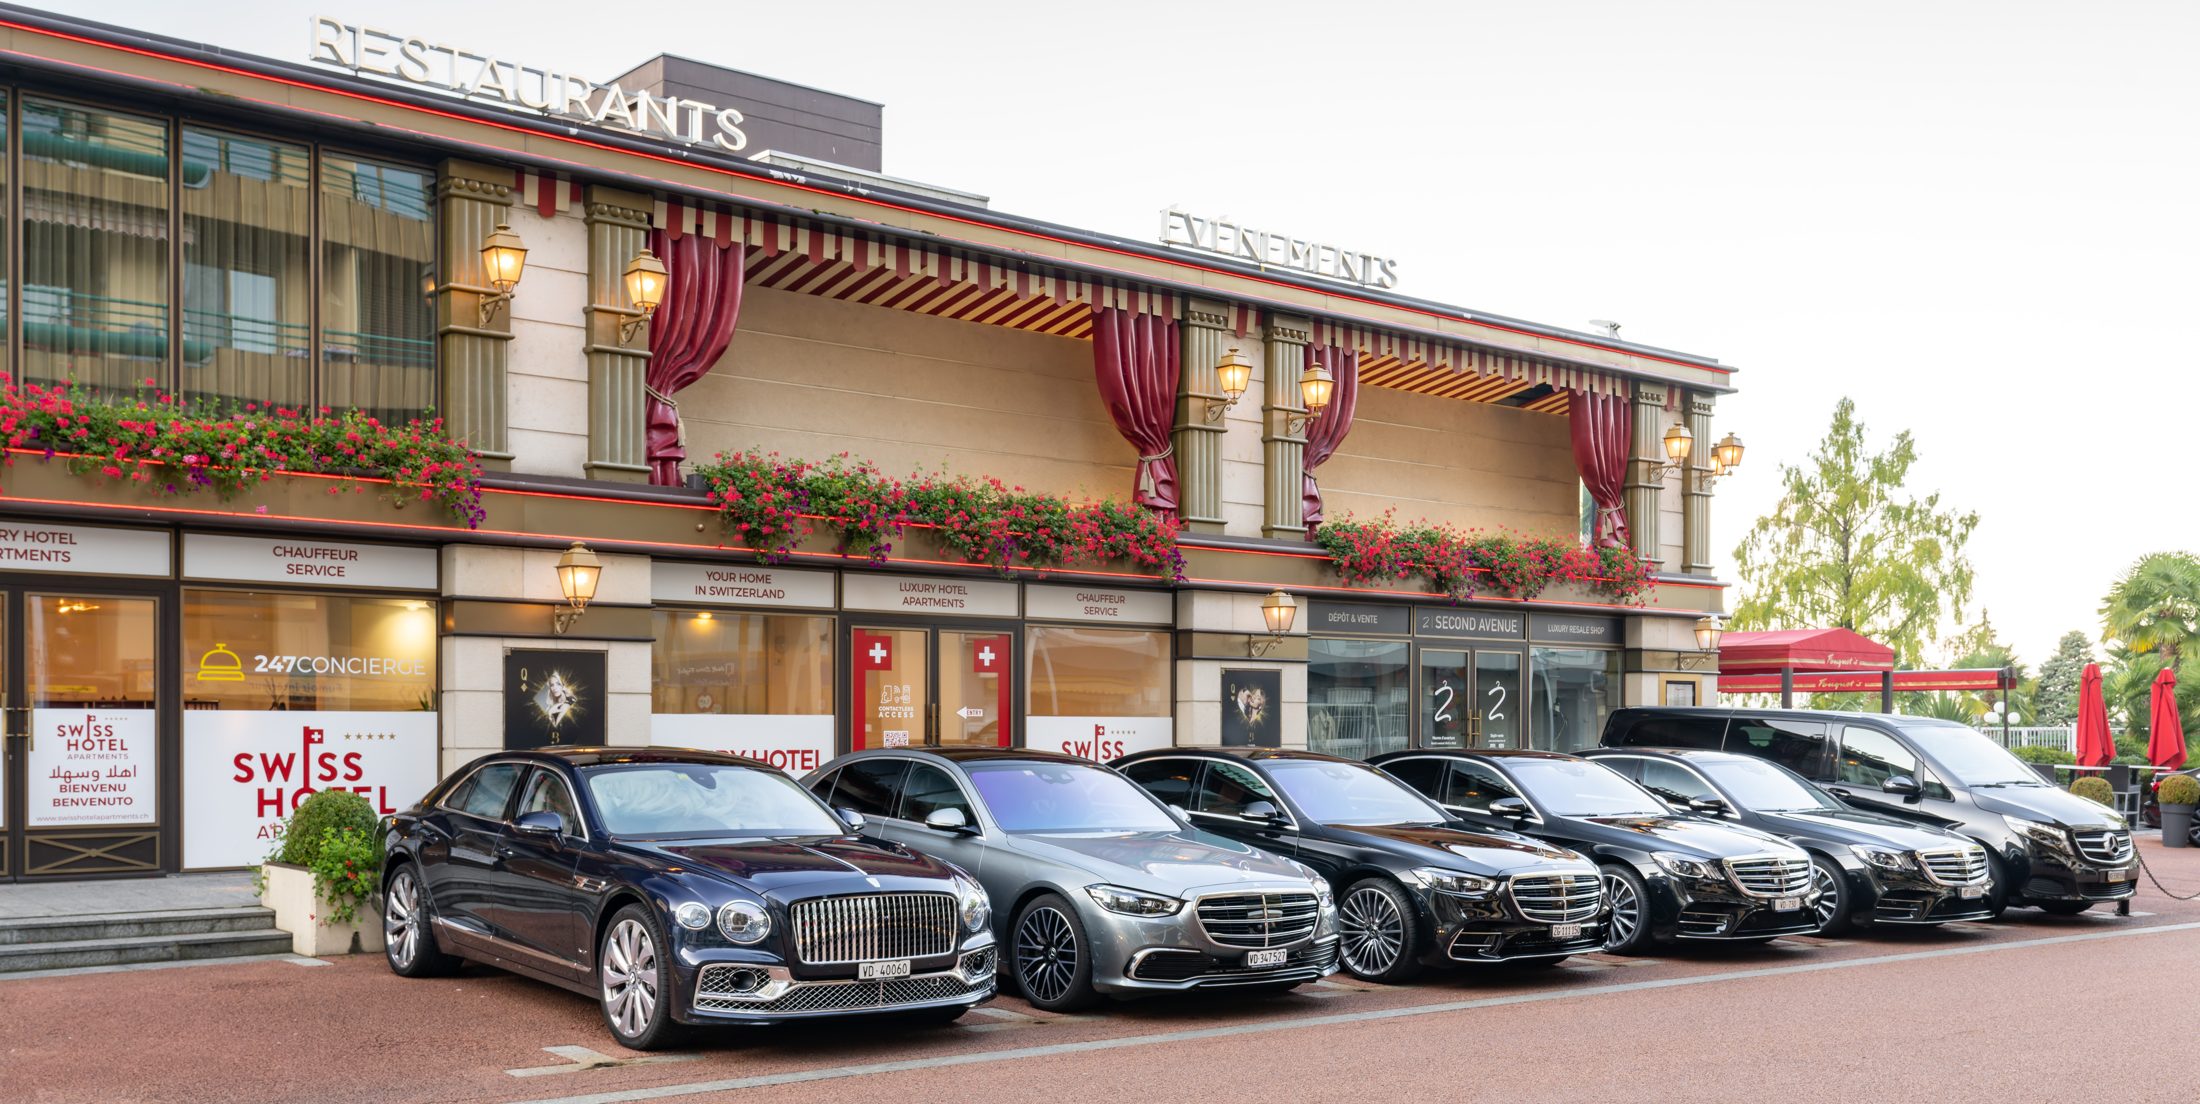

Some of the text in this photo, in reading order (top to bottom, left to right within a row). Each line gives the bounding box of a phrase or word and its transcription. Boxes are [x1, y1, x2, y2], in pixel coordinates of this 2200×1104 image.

[309, 14, 748, 151] RESTAURANTS
[24, 530, 77, 545] HOTEL
[273, 546, 358, 561] CHAUFFEUR
[286, 563, 345, 577] SERVICE
[706, 571, 772, 584] YOUR HOME
[695, 585, 785, 599] IN SWITZERLAND
[899, 582, 968, 595] LUXURY HOTEL
[902, 597, 965, 608] APARTMENTS
[1076, 593, 1126, 604] CHAUFFEUR
[1084, 606, 1118, 616] SERVICE
[1328, 612, 1350, 622] DÉPÔT
[1357, 614, 1378, 624] VENTE
[1435, 616, 1476, 631] SECOND
[1478, 617, 1518, 633] AVENUE
[1547, 624, 1605, 635] LUXURY RESALE SHOP
[57, 715, 113, 737] SWISS
[67, 739, 128, 751] HOTEL
[1062, 725, 1124, 760] SWISS
[233, 727, 363, 783] SWISS
[59, 783, 127, 793] BIENVENU
[52, 797, 133, 807] BENVENUTO
